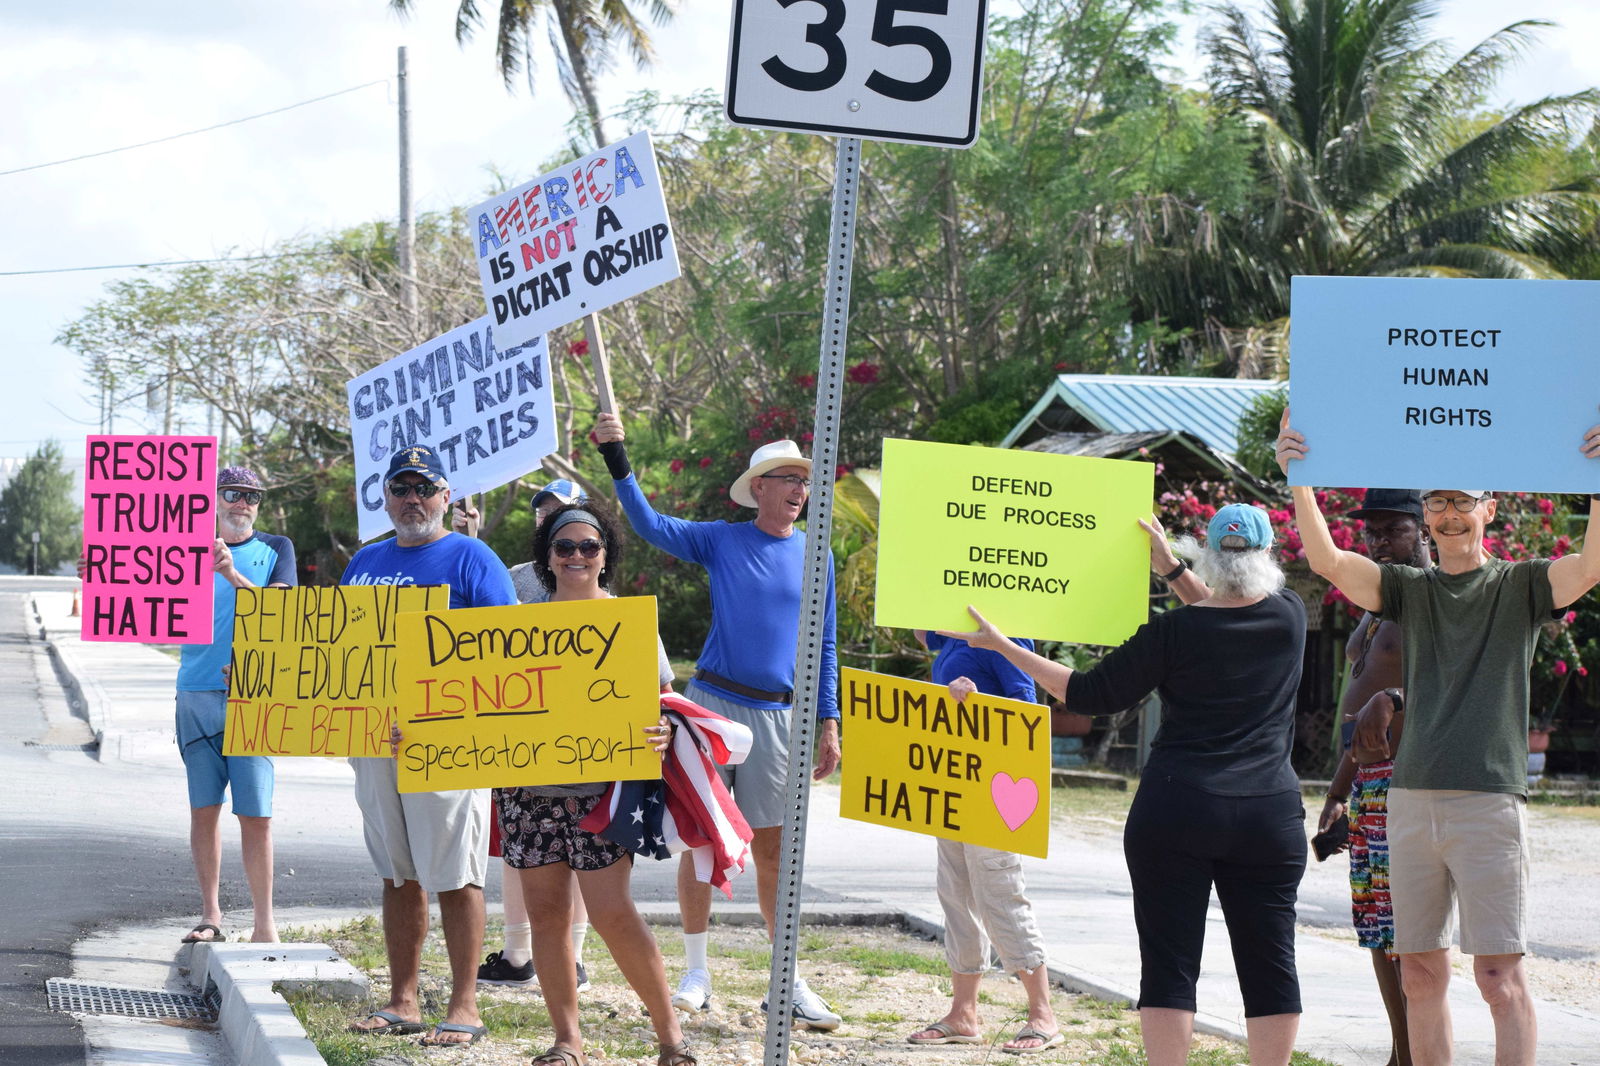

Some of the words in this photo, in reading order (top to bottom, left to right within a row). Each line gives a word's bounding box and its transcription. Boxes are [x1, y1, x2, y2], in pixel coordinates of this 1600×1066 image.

[761, 0, 951, 101] 35
[480, 146, 644, 258] AMERICA
[489, 251, 515, 284] IS
[520, 218, 578, 271] NOT
[595, 205, 622, 239] A
[1388, 328, 1501, 348] PROTECT
[1403, 367, 1489, 386] HUMAN
[369, 390, 455, 462] CAN'T
[473, 355, 543, 412] RUN
[1405, 407, 1492, 427] RIGHTS
[89, 441, 212, 481] RESIST
[972, 475, 1053, 497] DEFEND
[91, 493, 210, 533] TRUMP
[946, 502, 987, 520] DUE
[1004, 507, 1097, 530] PROCESS
[86, 545, 208, 585] RESIST
[969, 546, 1048, 568] DEFEND
[943, 570, 1070, 595] DEMOCRACY
[93, 597, 189, 637] HATE
[232, 586, 347, 644] RETIRED
[424, 614, 621, 670] Democracy
[228, 647, 275, 699] NOW
[415, 679, 466, 717] IS
[472, 665, 562, 711] NOT
[588, 678, 630, 702] a
[227, 699, 298, 754] TWICE
[310, 705, 397, 756] BETRA
[849, 680, 1042, 751] HUMANITY
[405, 734, 548, 780] spectator
[555, 722, 645, 776] sport
[908, 743, 982, 783] OVER
[864, 776, 962, 831] HATE
